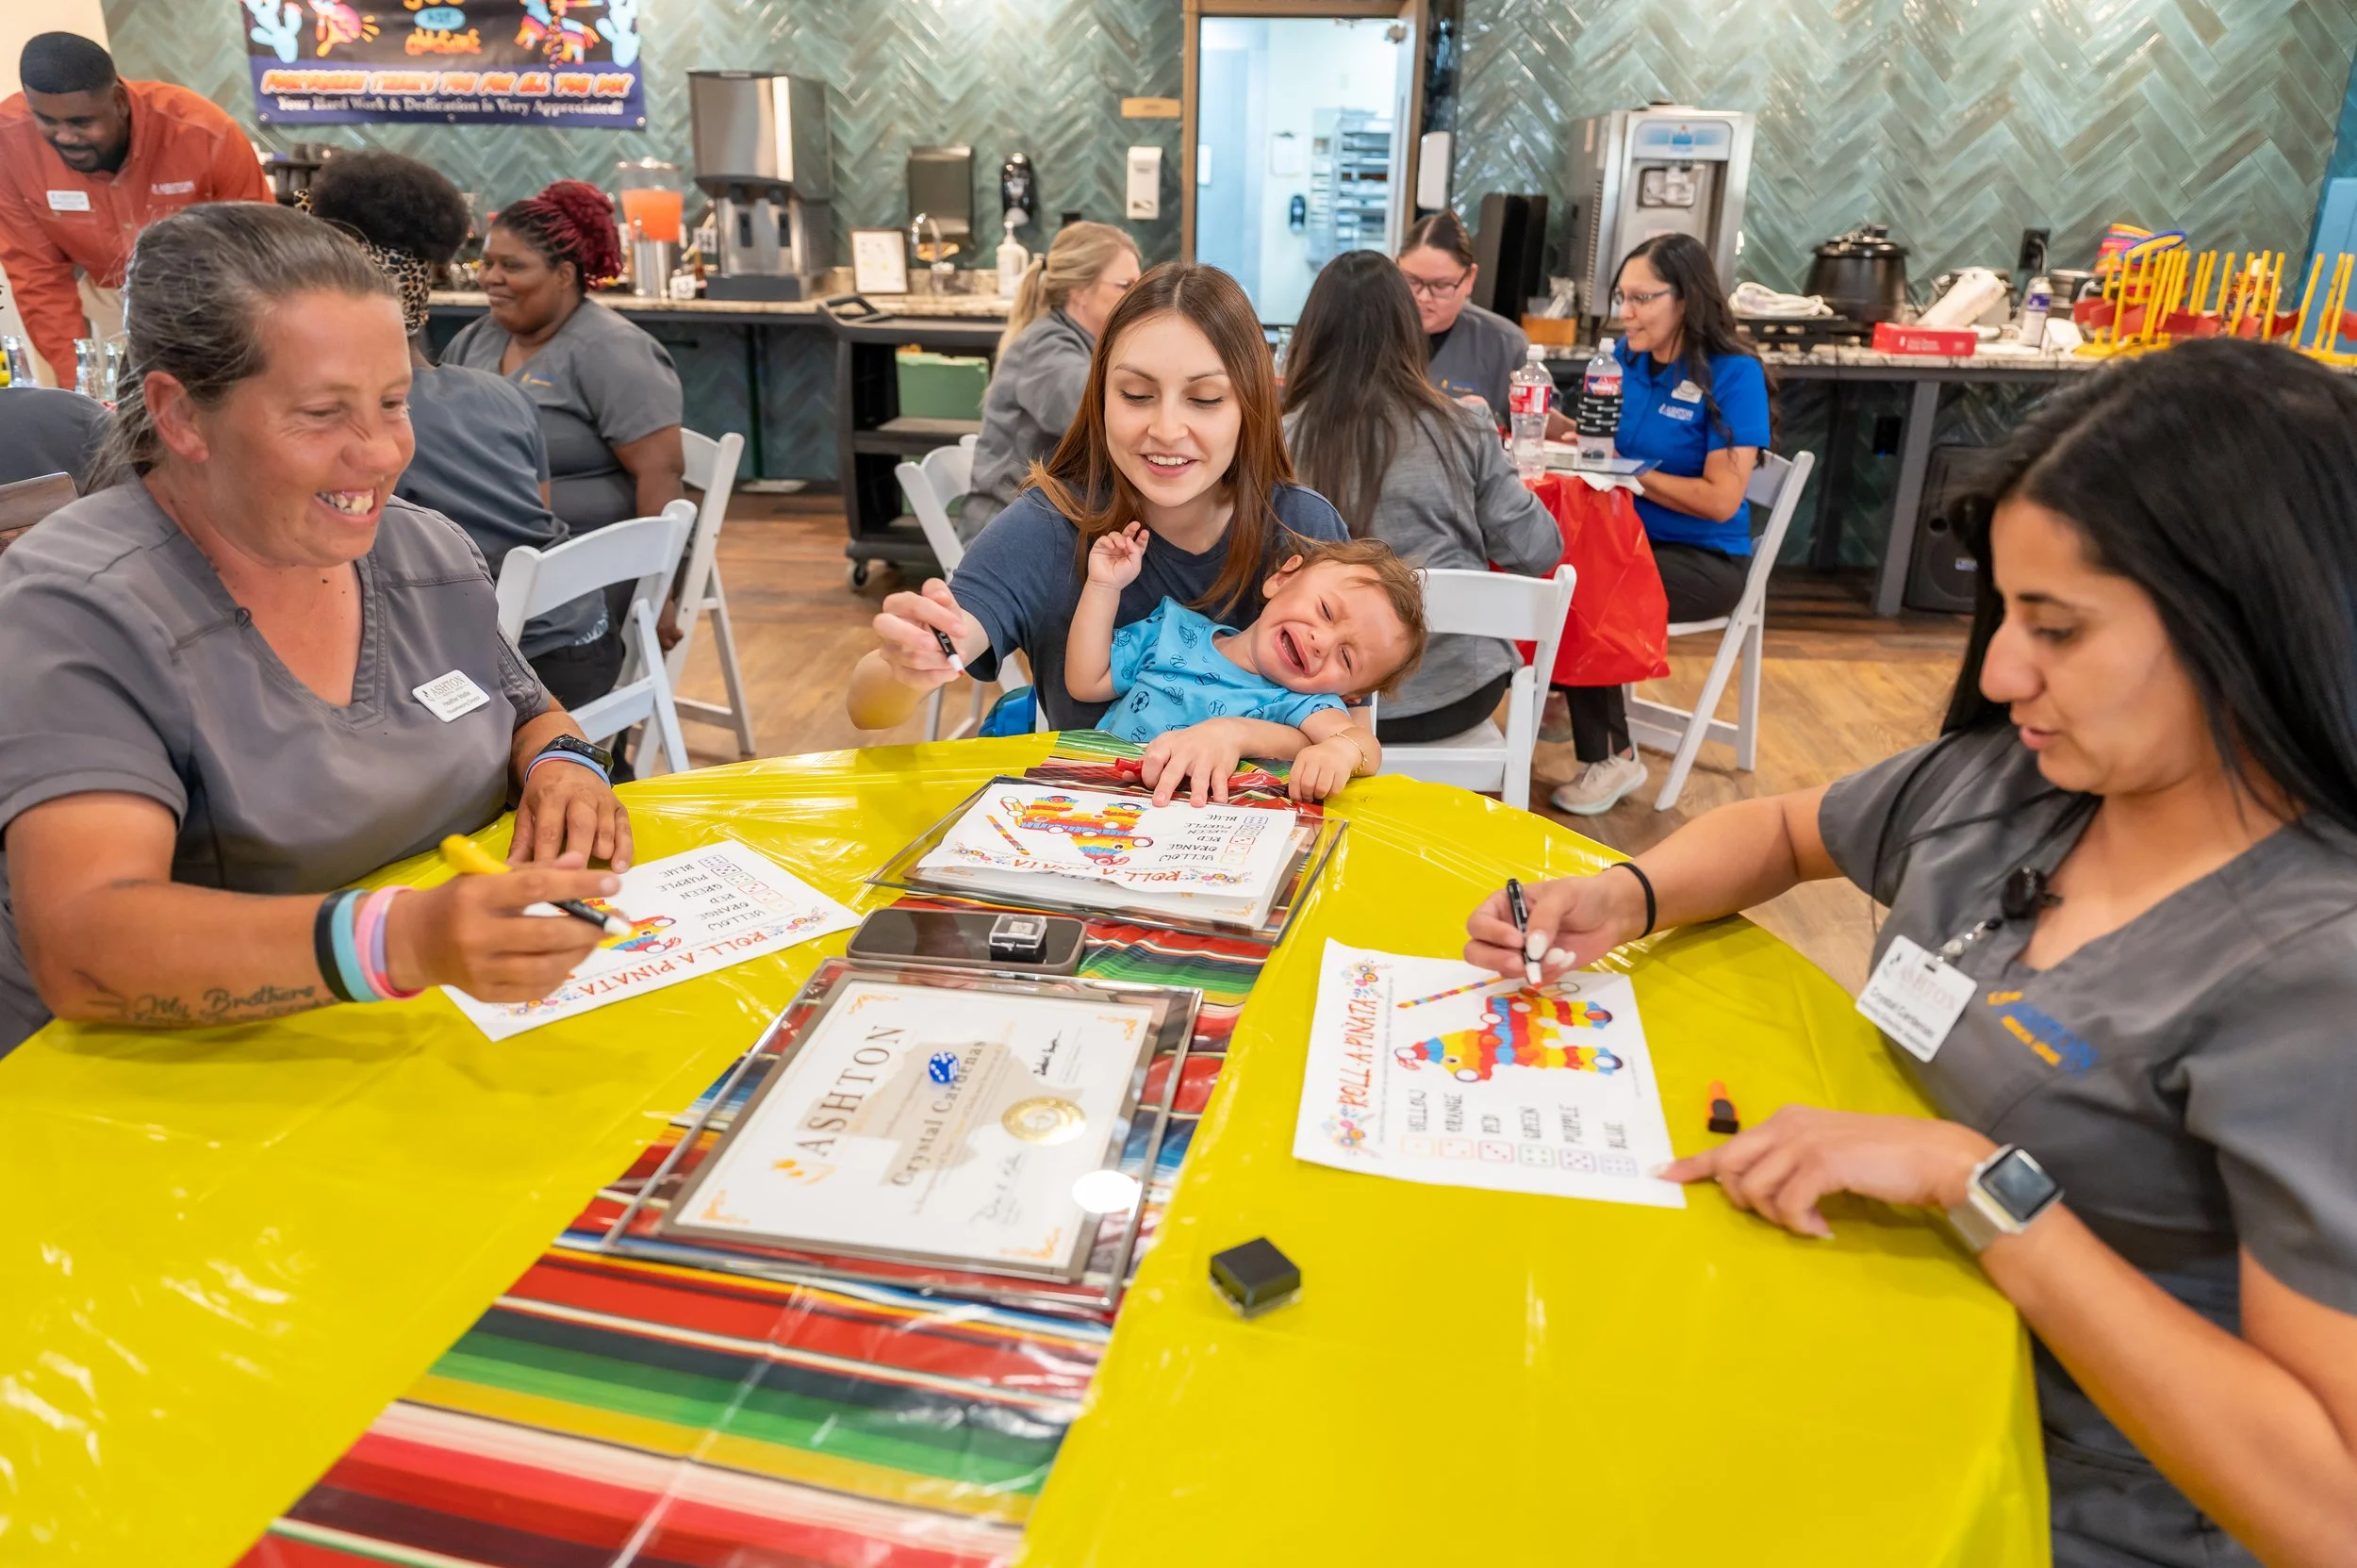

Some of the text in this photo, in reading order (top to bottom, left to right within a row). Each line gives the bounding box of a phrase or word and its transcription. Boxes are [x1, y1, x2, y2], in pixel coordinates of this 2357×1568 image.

[349, 96, 387, 110] Work
[388, 96, 402, 111] &
[404, 96, 480, 114] Dedication
[495, 98, 530, 117] Very
[430, 675, 466, 697] ASHTON
[1206, 814, 1237, 822] BLUE
[1159, 852, 1214, 862] YELLOW
[1166, 843, 1217, 851] ORANGE
[658, 864, 695, 878] BLUE
[656, 874, 708, 892] PURPLE
[680, 883, 722, 900] GREEN
[709, 893, 736, 904] RED
[696, 901, 749, 920] ORANGE
[707, 909, 766, 931] YELLOW
[796, 1025, 905, 1157] ASHTON
[1408, 1088, 1427, 1132] YELLOW
[1443, 1092, 1463, 1132] ORANGE
[1481, 1114, 1501, 1134] RED
[1519, 1106, 1541, 1140] GREEN
[1558, 1103, 1583, 1145] PURPLE
[1603, 1121, 1627, 1149] BLUE
[892, 1117, 943, 1187] Crystal
